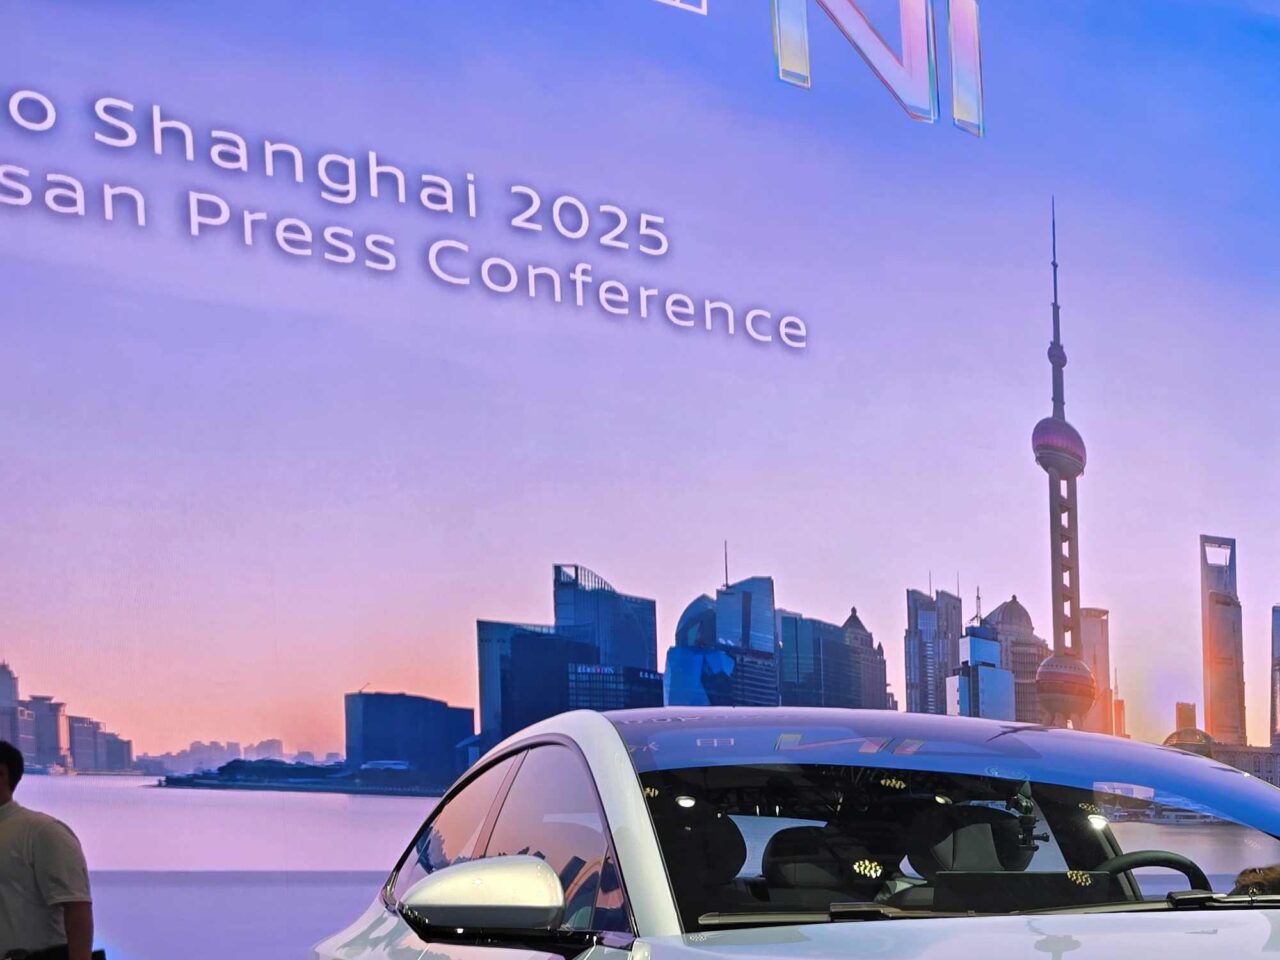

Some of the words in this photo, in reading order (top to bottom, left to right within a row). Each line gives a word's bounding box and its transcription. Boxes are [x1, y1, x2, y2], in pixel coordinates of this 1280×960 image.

[0, 164, 146, 226] san
[189, 191, 396, 271] Press
[428, 239, 807, 348] Conference
[94, 97, 476, 218] Shanghai
[511, 185, 669, 256] 2025
